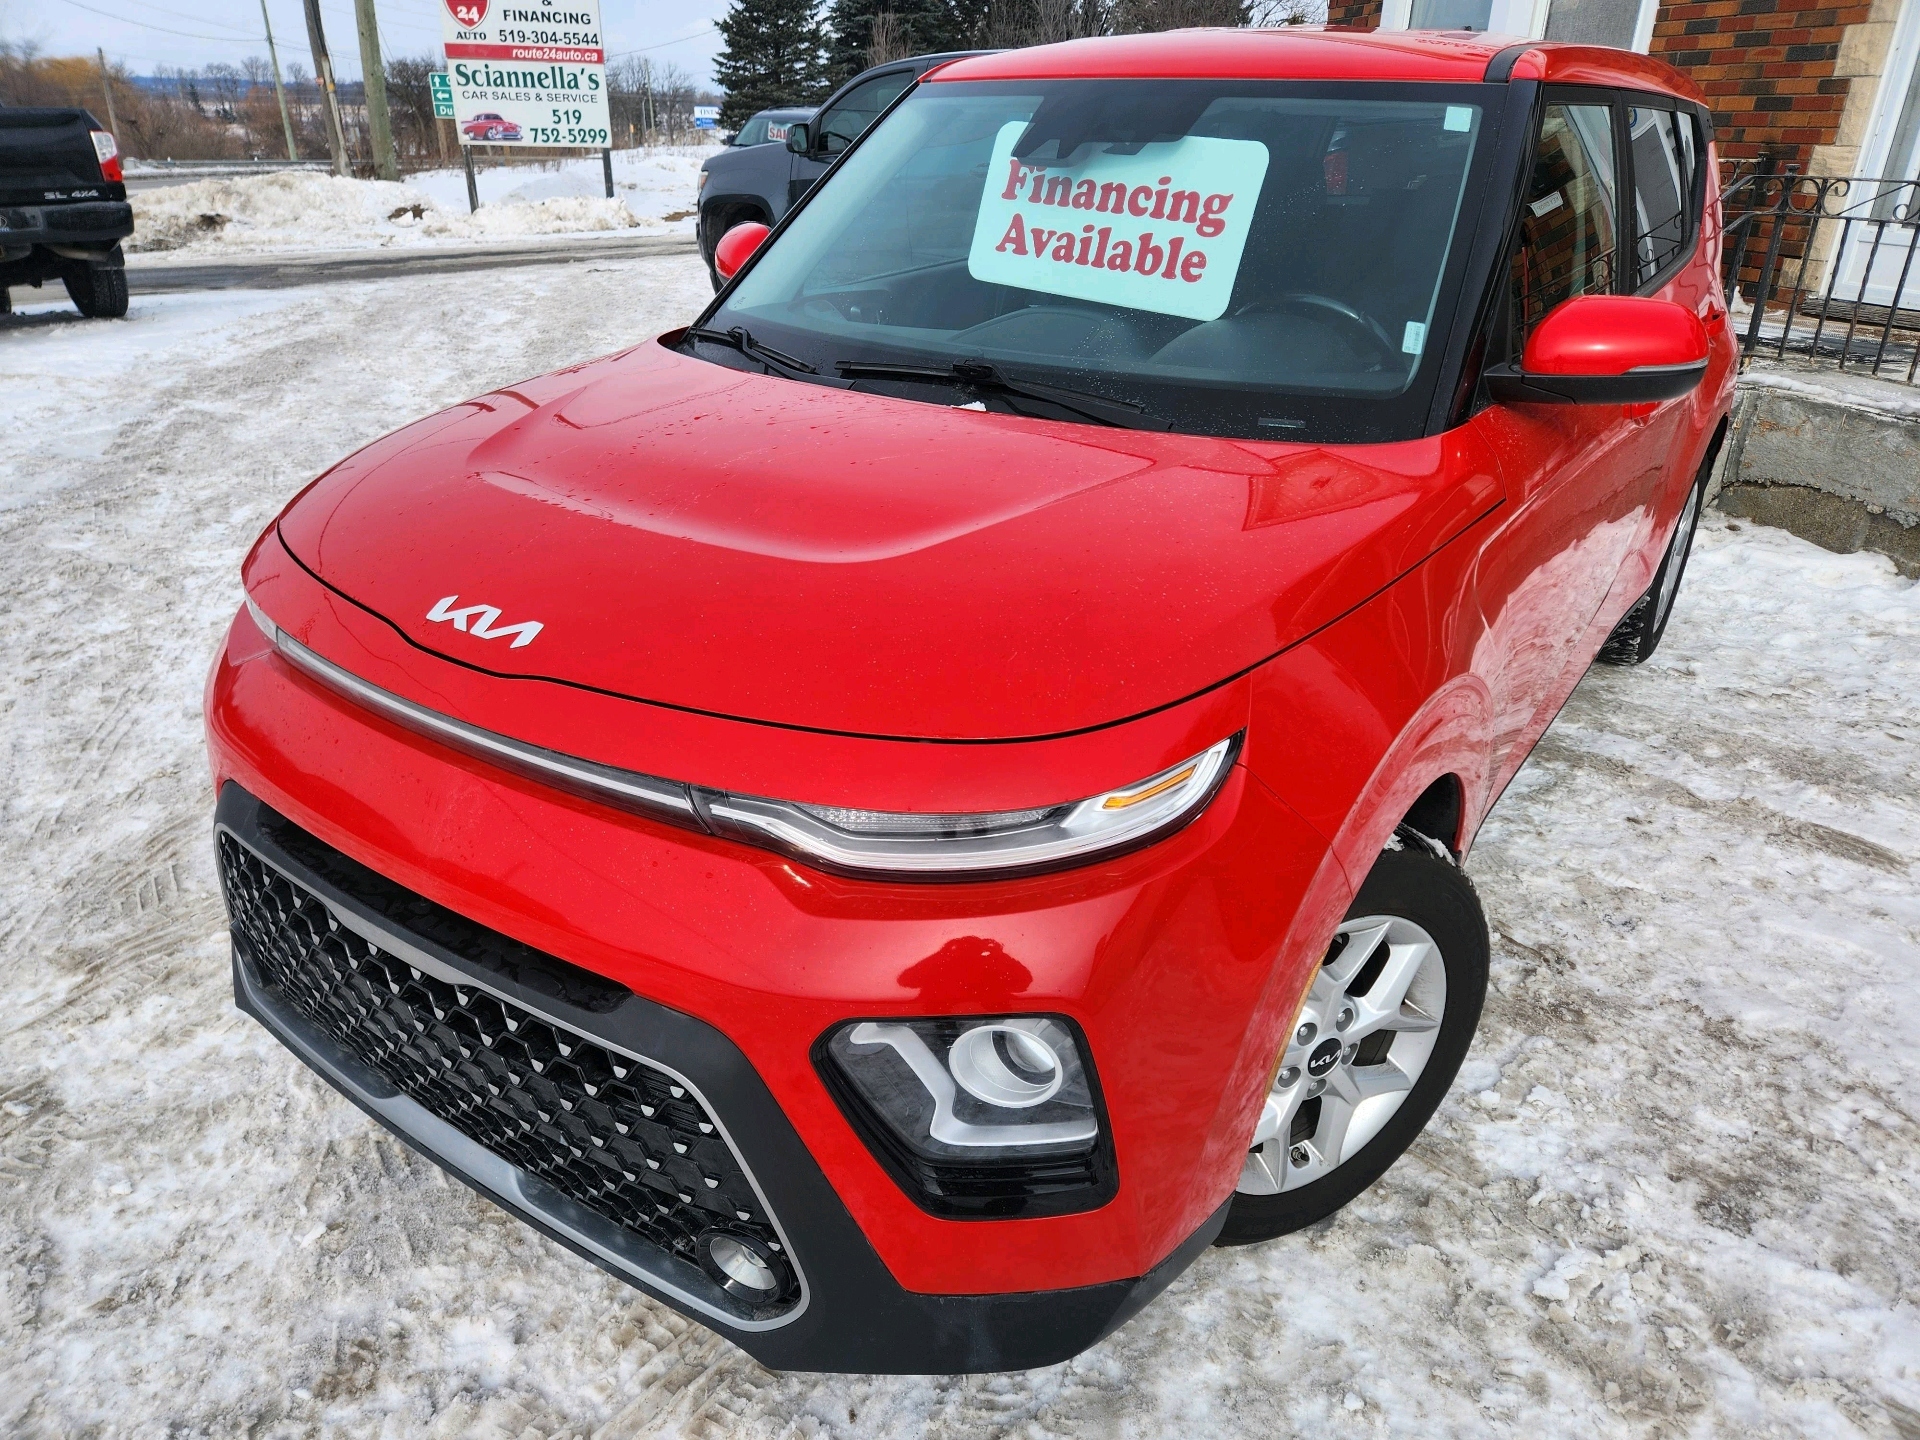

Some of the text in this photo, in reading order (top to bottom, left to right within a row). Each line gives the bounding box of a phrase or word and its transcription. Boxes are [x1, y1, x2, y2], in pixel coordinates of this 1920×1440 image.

[457, 6, 479, 22] 24
[503, 10, 591, 24] FINANCING
[456, 31, 486, 40] AUTO
[499, 29, 599, 46] 519-304-5544
[512, 48, 598, 62] route24auto.ca
[455, 63, 600, 90] Sciannella's
[462, 91, 597, 103] CAR SALES & SERVICE
[552, 109, 582, 125] 519
[530, 128, 607, 144] 752-5299
[1002, 159, 1234, 237] Financing
[995, 213, 1207, 283] Available
